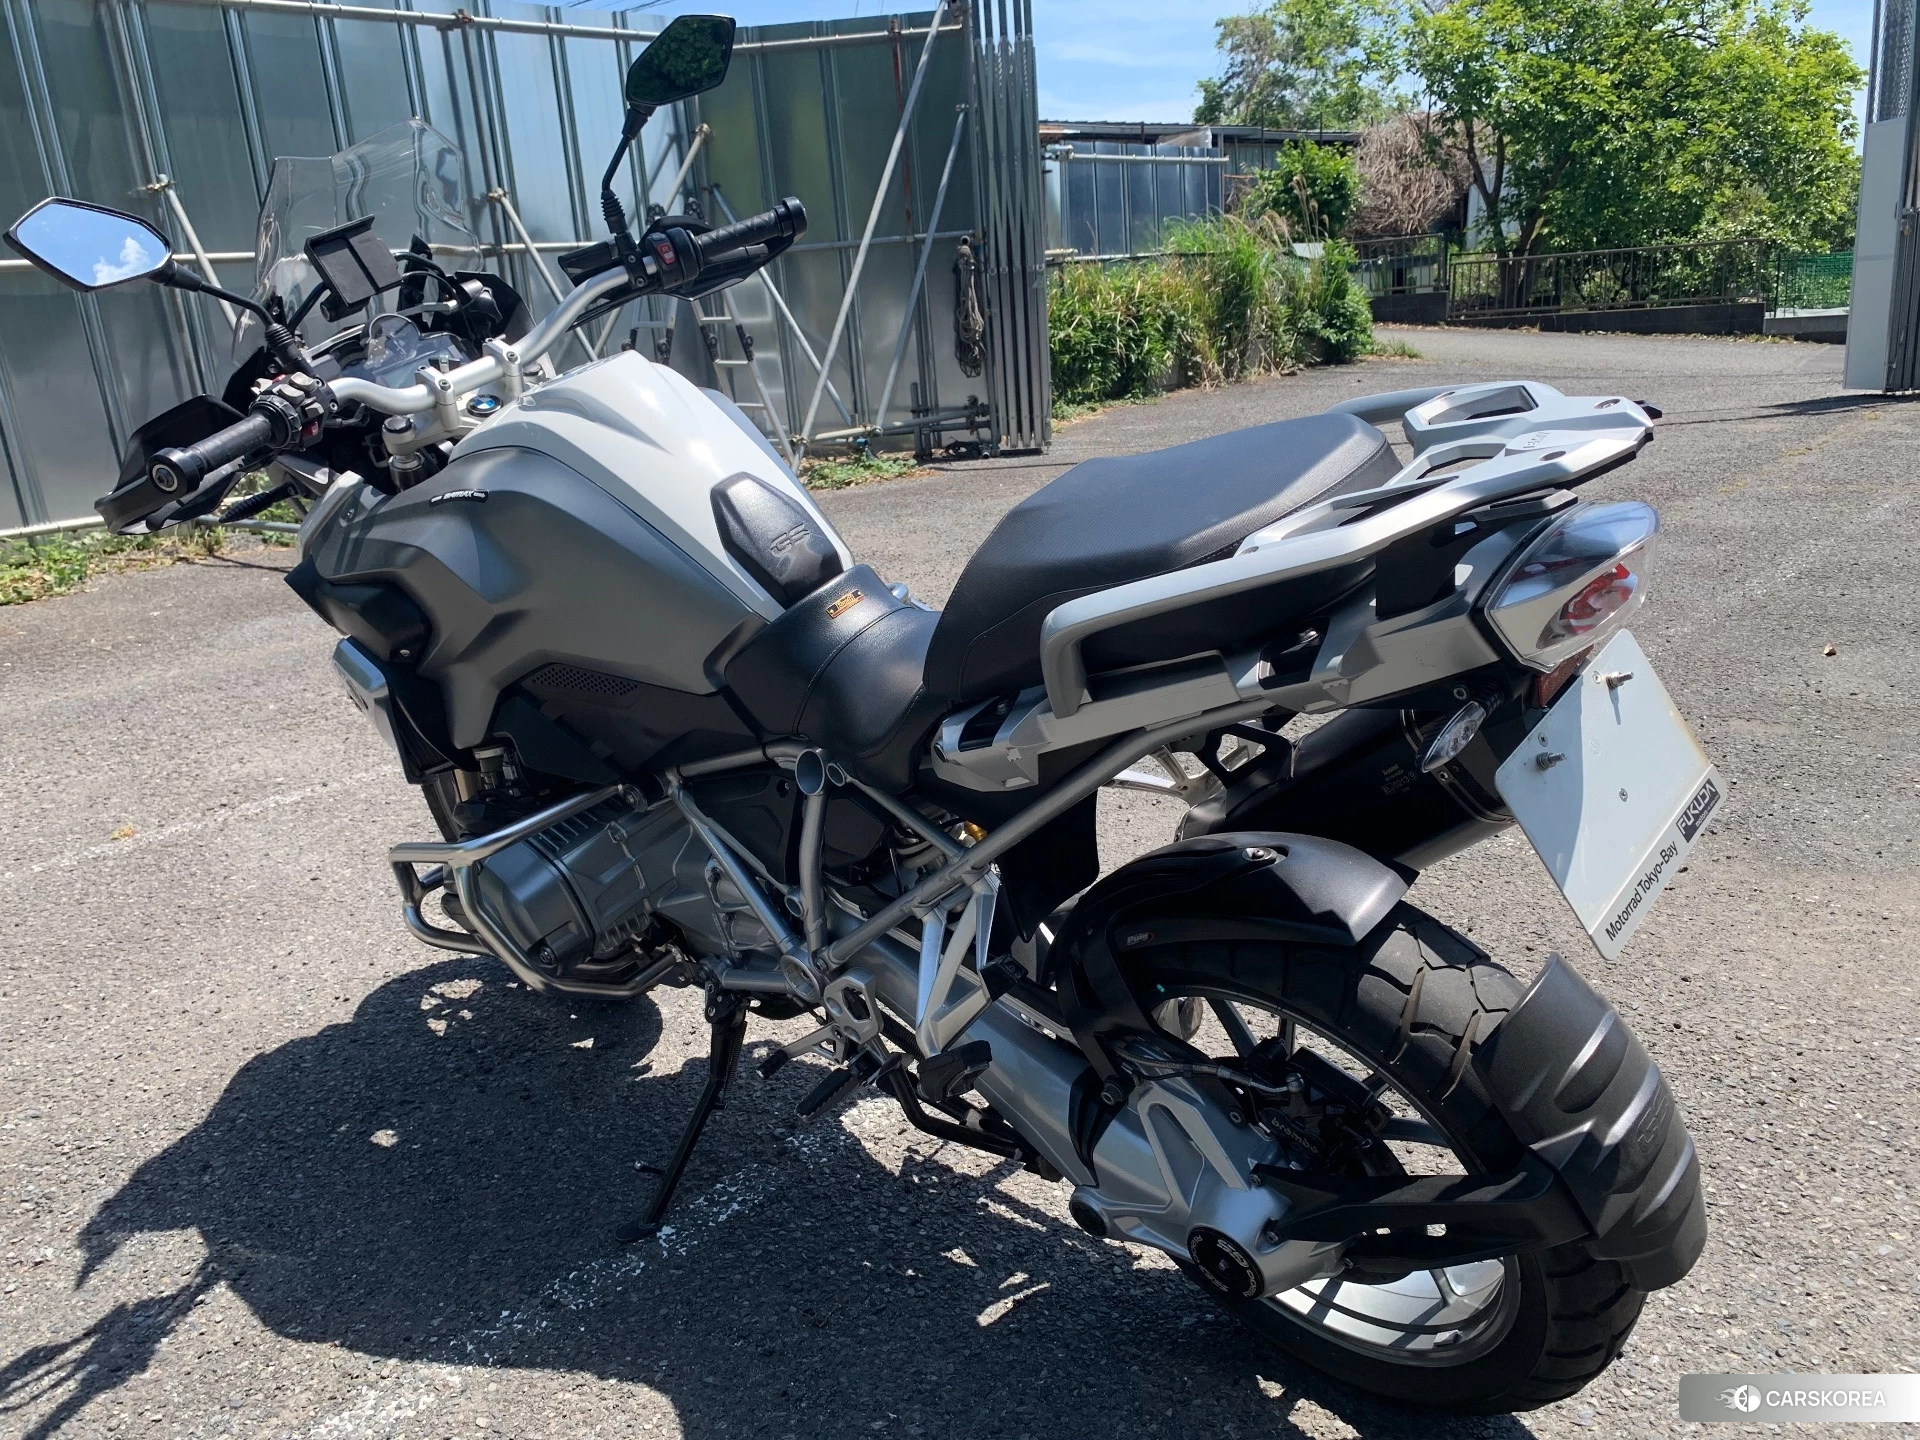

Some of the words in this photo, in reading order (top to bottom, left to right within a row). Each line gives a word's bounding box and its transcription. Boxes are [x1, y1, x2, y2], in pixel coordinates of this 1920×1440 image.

[770, 522, 811, 558] GS
[1677, 783, 1716, 835] FUKUDA
[1605, 888, 1642, 941] Motorrad
[1636, 841, 1679, 894] Tokyo-Bay
[1126, 933, 1149, 945] Puig
[1271, 1116, 1319, 1154] brembo
[1637, 1084, 1670, 1153] GS
[1216, 1239, 1250, 1268] GS
